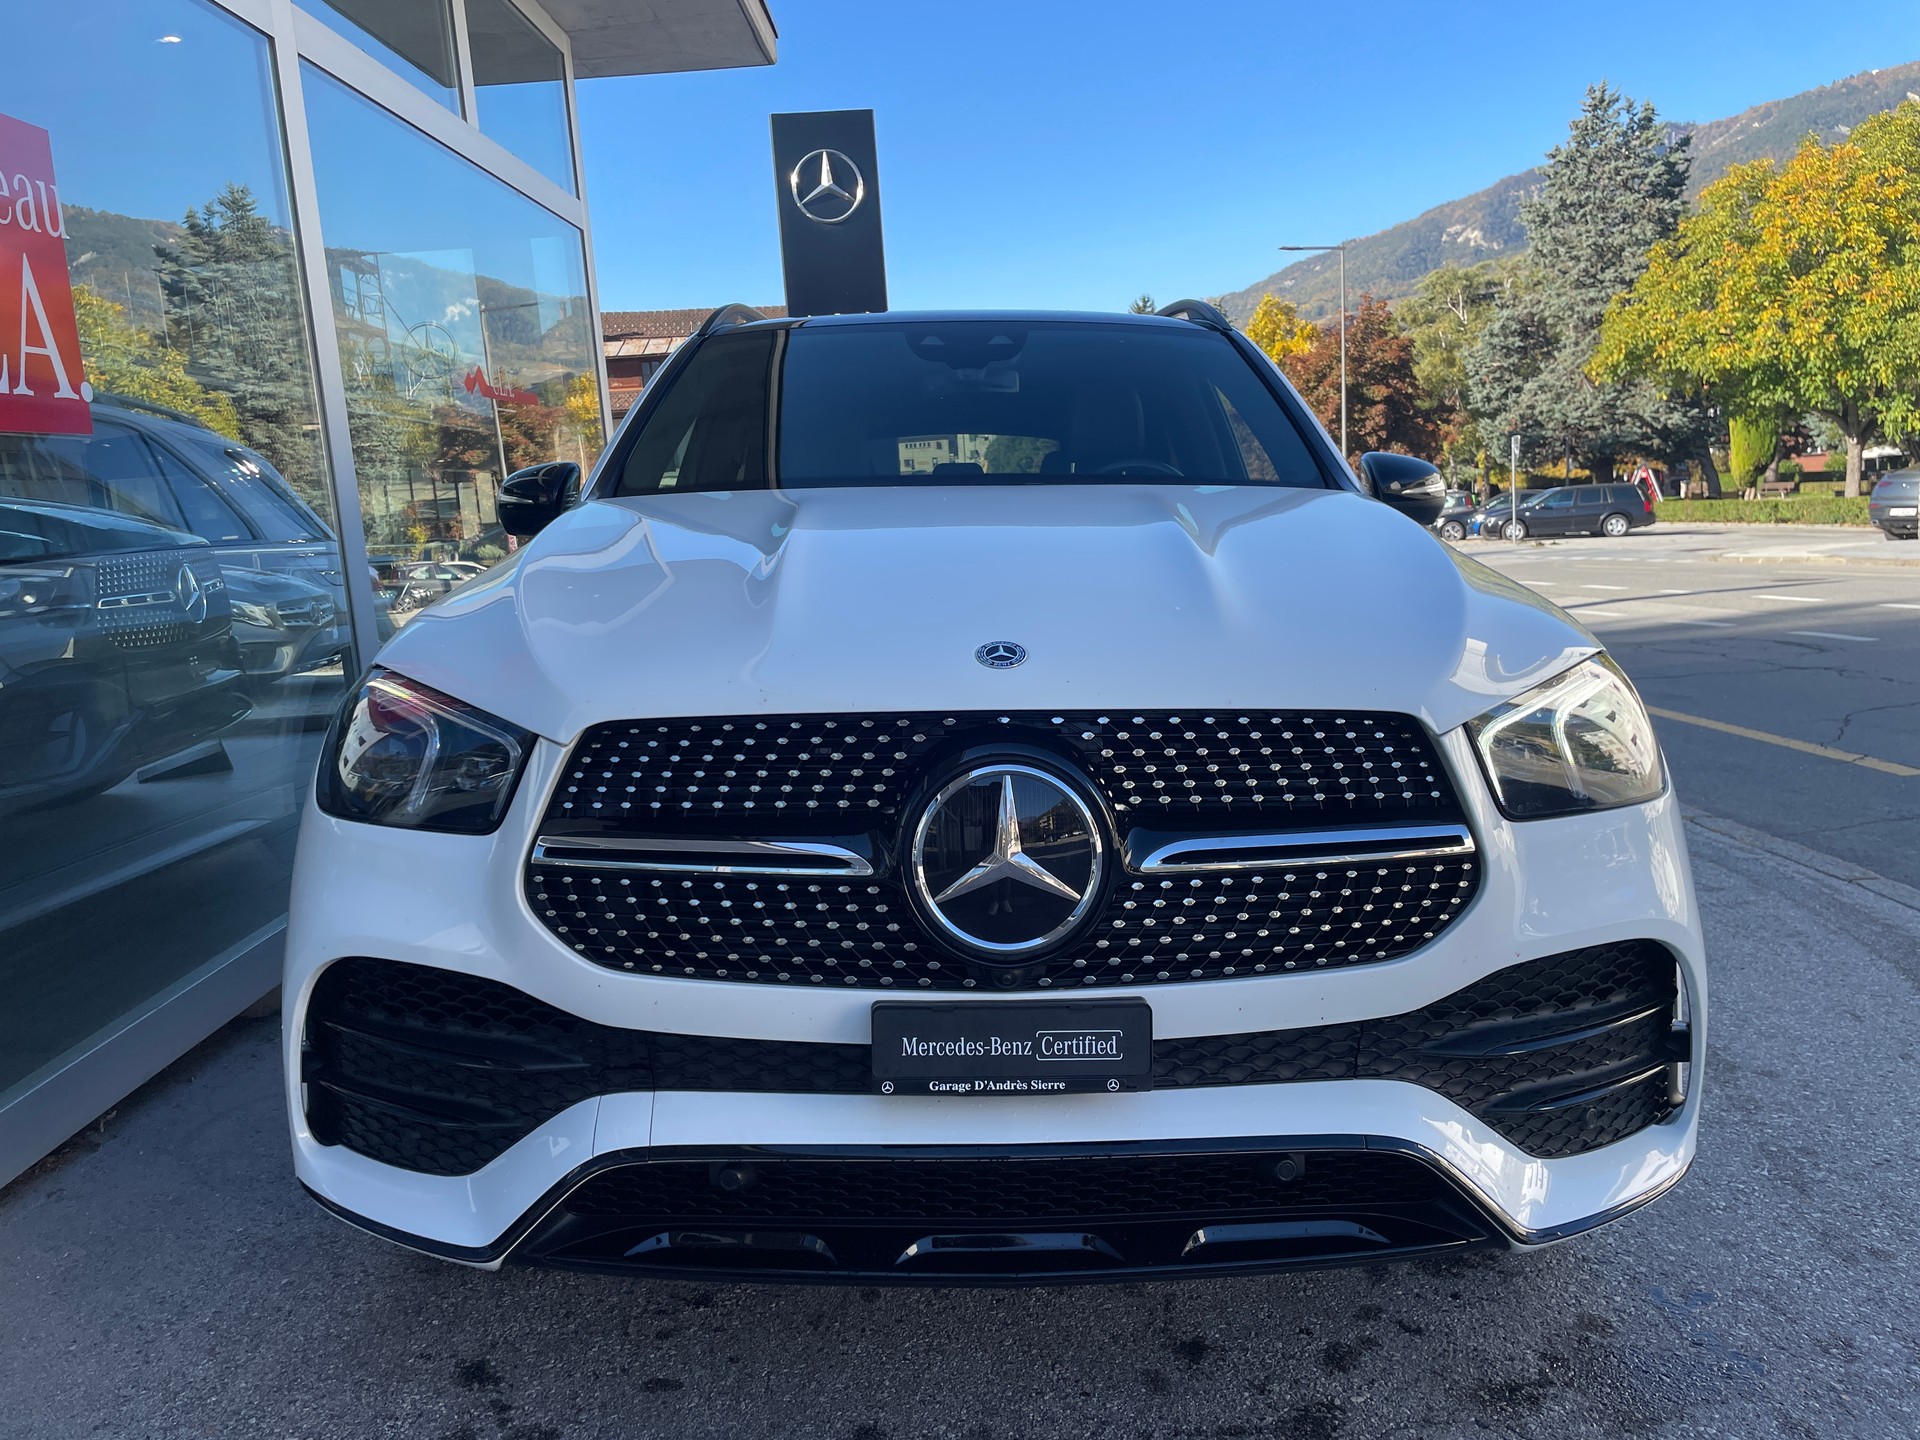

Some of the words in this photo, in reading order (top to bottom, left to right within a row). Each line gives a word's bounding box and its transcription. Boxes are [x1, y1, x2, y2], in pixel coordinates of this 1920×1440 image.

[0, 253, 94, 403] A.
[901, 1036, 1033, 1056] Mercedes-Benz
[1041, 1035, 1118, 1056] Certified
[929, 1080, 972, 1093] Garage
[974, 1079, 1028, 1091] D'Andrès
[1030, 1079, 1066, 1091] Sierre
